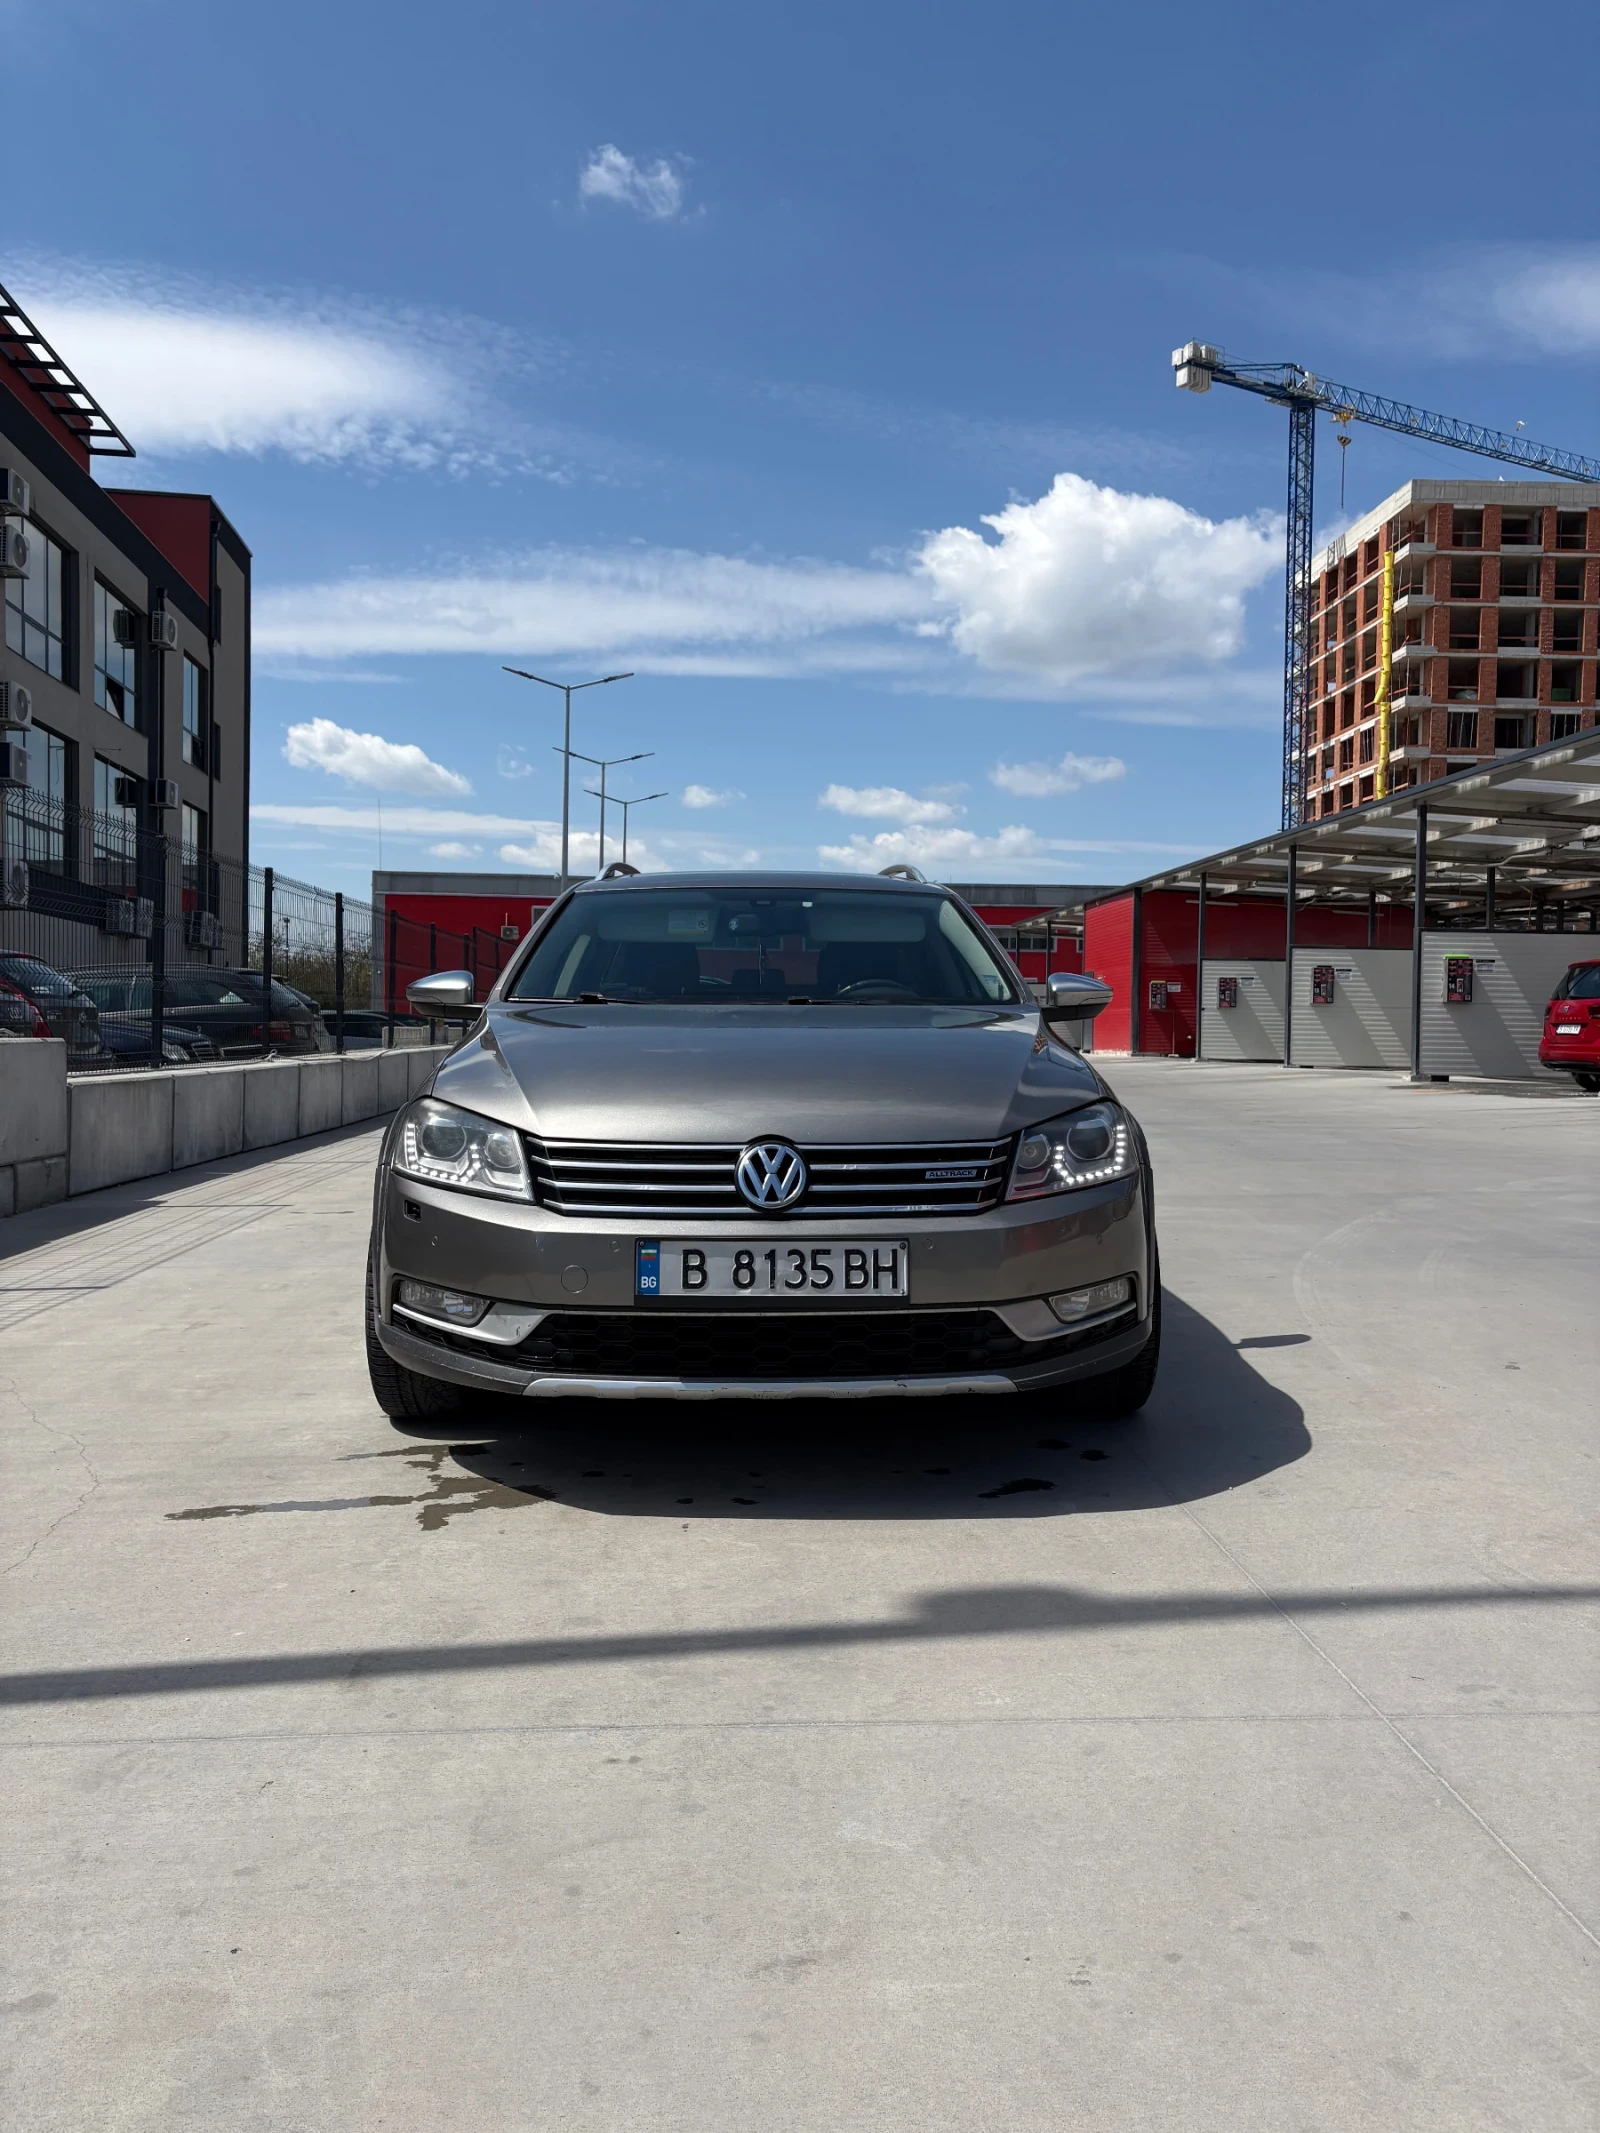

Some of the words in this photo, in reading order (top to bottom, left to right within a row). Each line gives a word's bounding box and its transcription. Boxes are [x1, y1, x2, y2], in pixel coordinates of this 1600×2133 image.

[929, 1170, 974, 1178] ALLTRACK
[682, 1249, 708, 1289] B
[641, 1276, 657, 1288] BG
